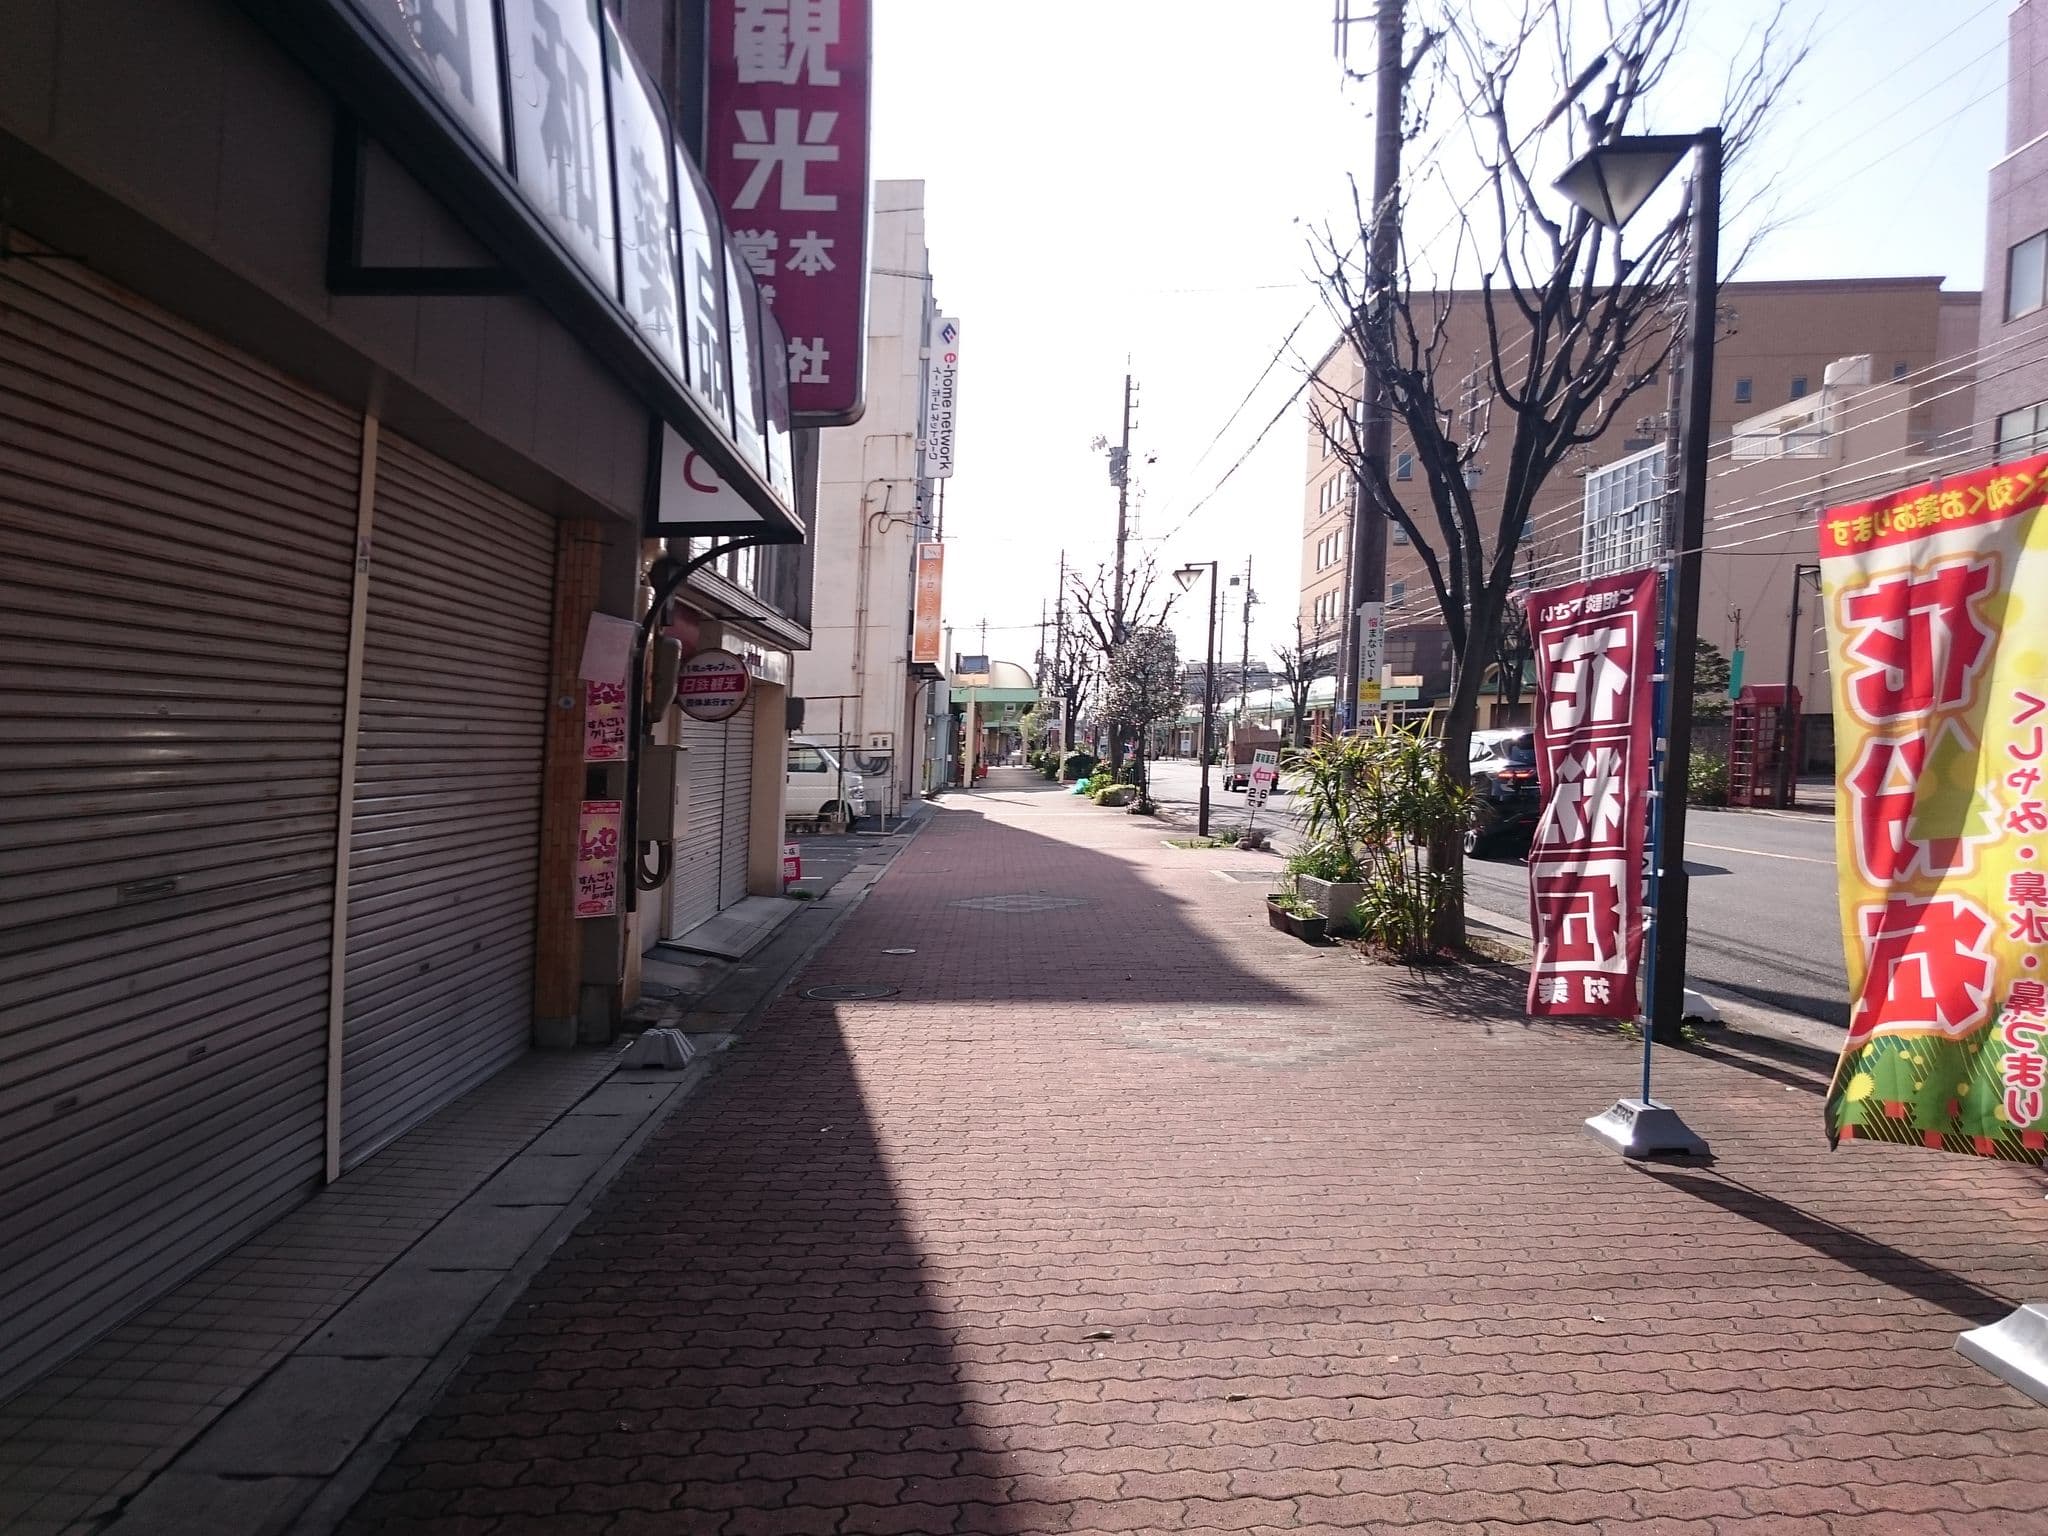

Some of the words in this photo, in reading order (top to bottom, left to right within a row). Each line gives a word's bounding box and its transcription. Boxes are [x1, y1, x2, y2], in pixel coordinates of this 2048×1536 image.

[732, 0, 840, 212] 観光
[939, 410, 953, 470] network
[581, 827, 617, 848] しわ
